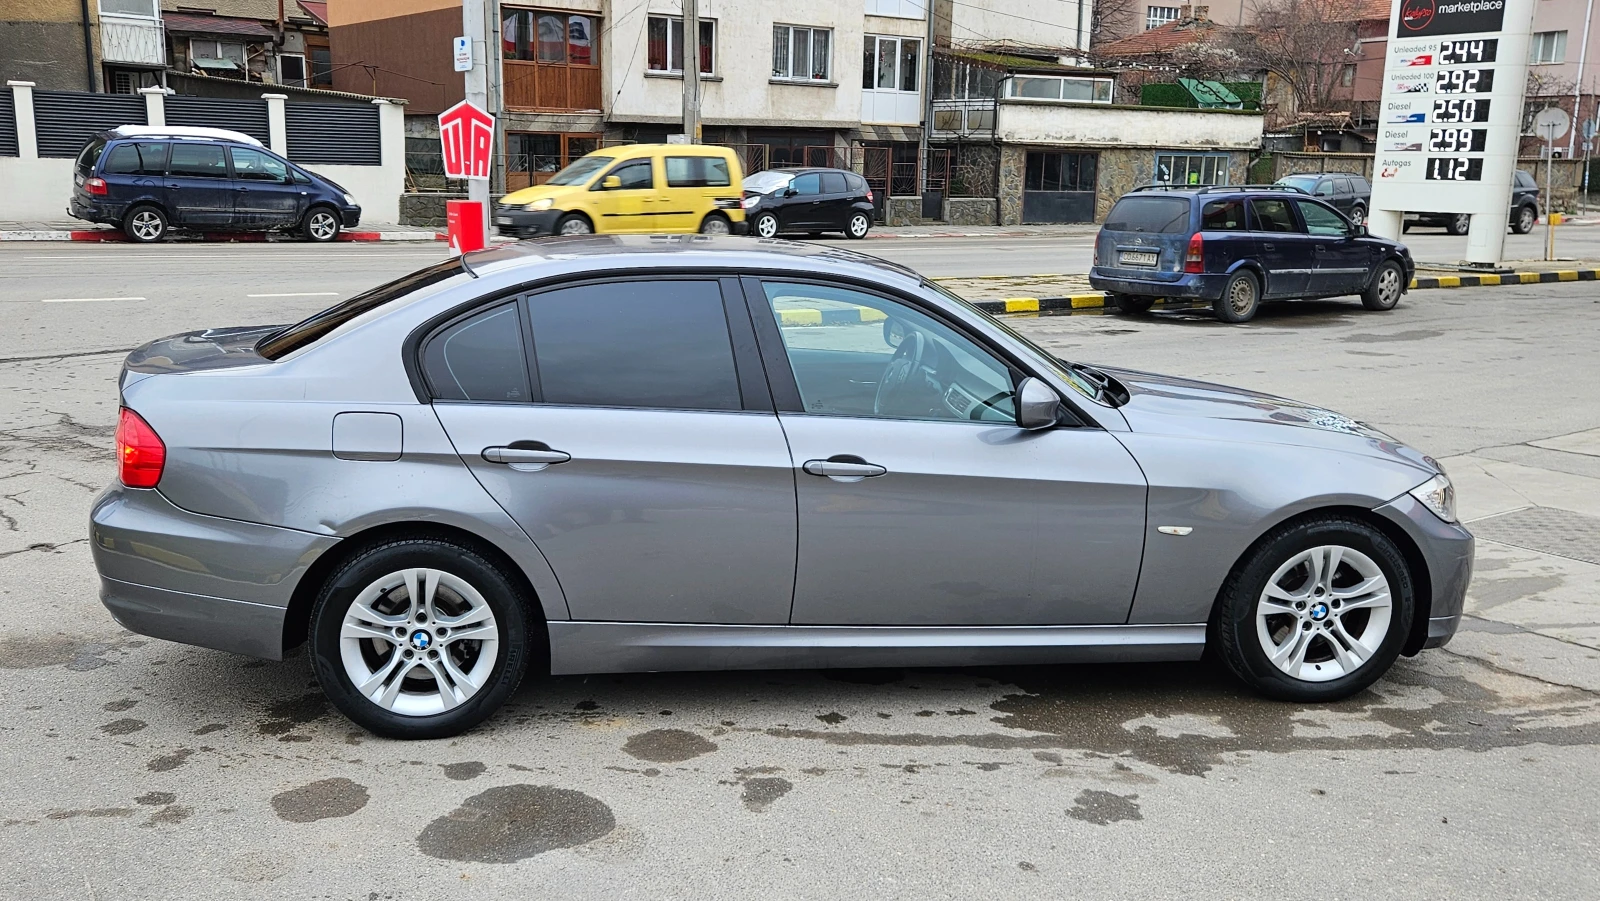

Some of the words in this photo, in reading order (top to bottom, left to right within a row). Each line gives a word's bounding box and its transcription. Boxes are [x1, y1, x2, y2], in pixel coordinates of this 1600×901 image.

[1438, 0, 1503, 14] marketplace
[1394, 44, 1427, 54] Unleaded
[1428, 44, 1437, 52] 95
[1439, 41, 1484, 65] 2.44
[1391, 72, 1421, 81] Unleaded
[1435, 69, 1480, 94] 2.92
[1388, 102, 1411, 110] Diesel
[1432, 99, 1476, 123] 2.50
[440, 103, 493, 177] UTA
[1385, 131, 1408, 139] Diesel
[1429, 128, 1473, 152] 2.99
[1382, 159, 1412, 168] Autogas
